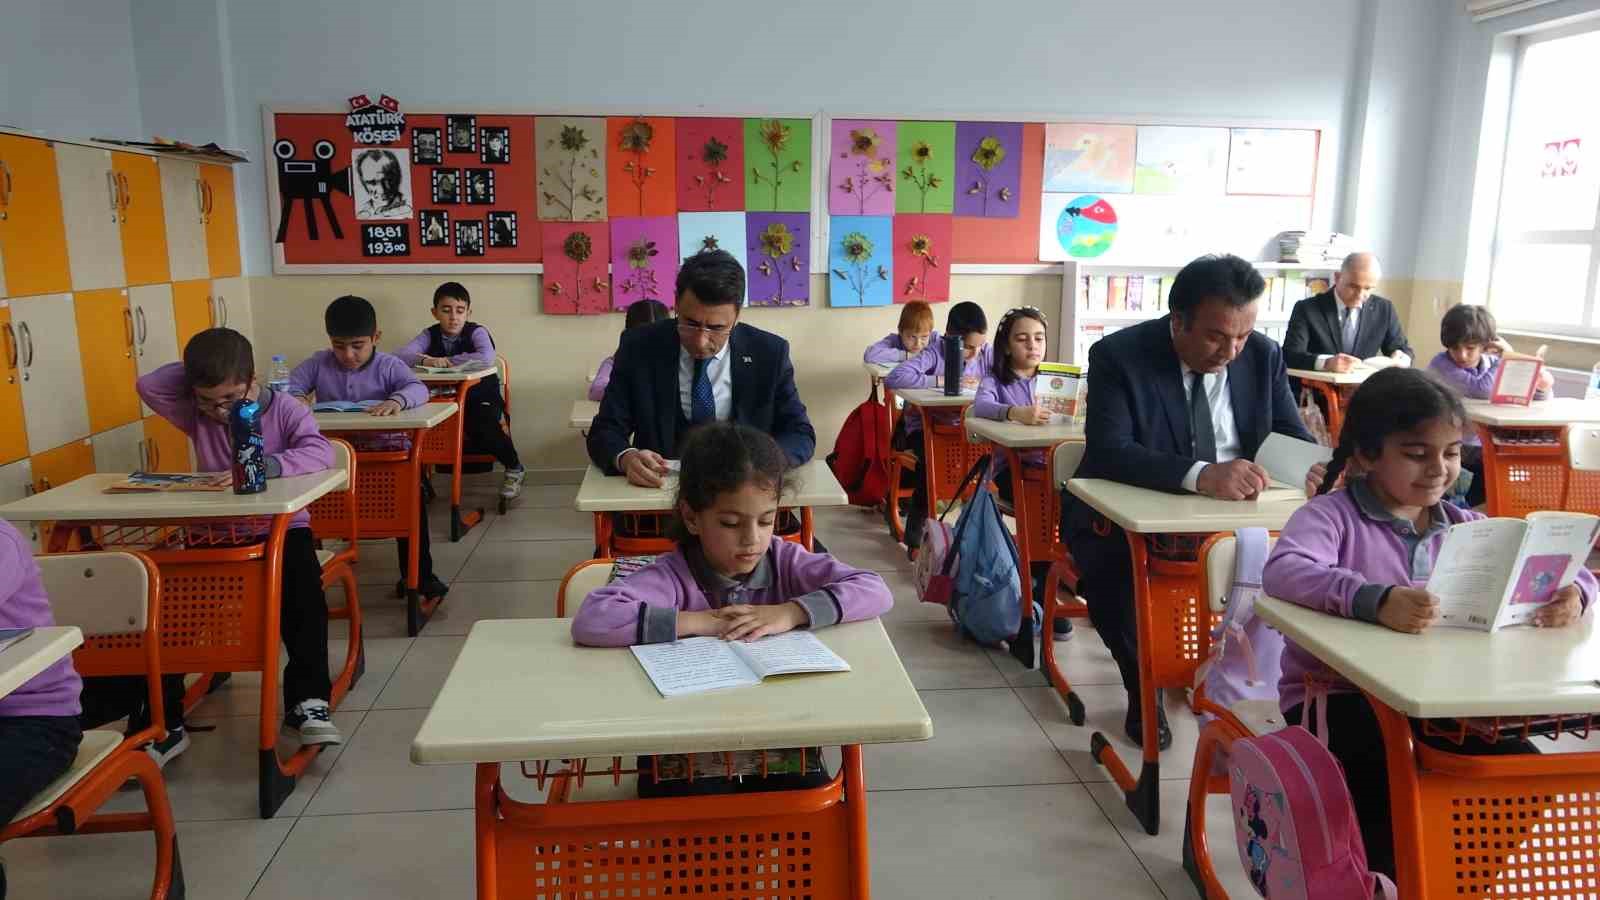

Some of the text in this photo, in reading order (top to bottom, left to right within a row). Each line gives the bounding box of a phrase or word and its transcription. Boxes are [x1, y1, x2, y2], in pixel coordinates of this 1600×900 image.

[345, 109, 405, 126] ATATÜRK
[353, 126, 400, 144] KÖŞESİ
[367, 226, 401, 238] 1881
